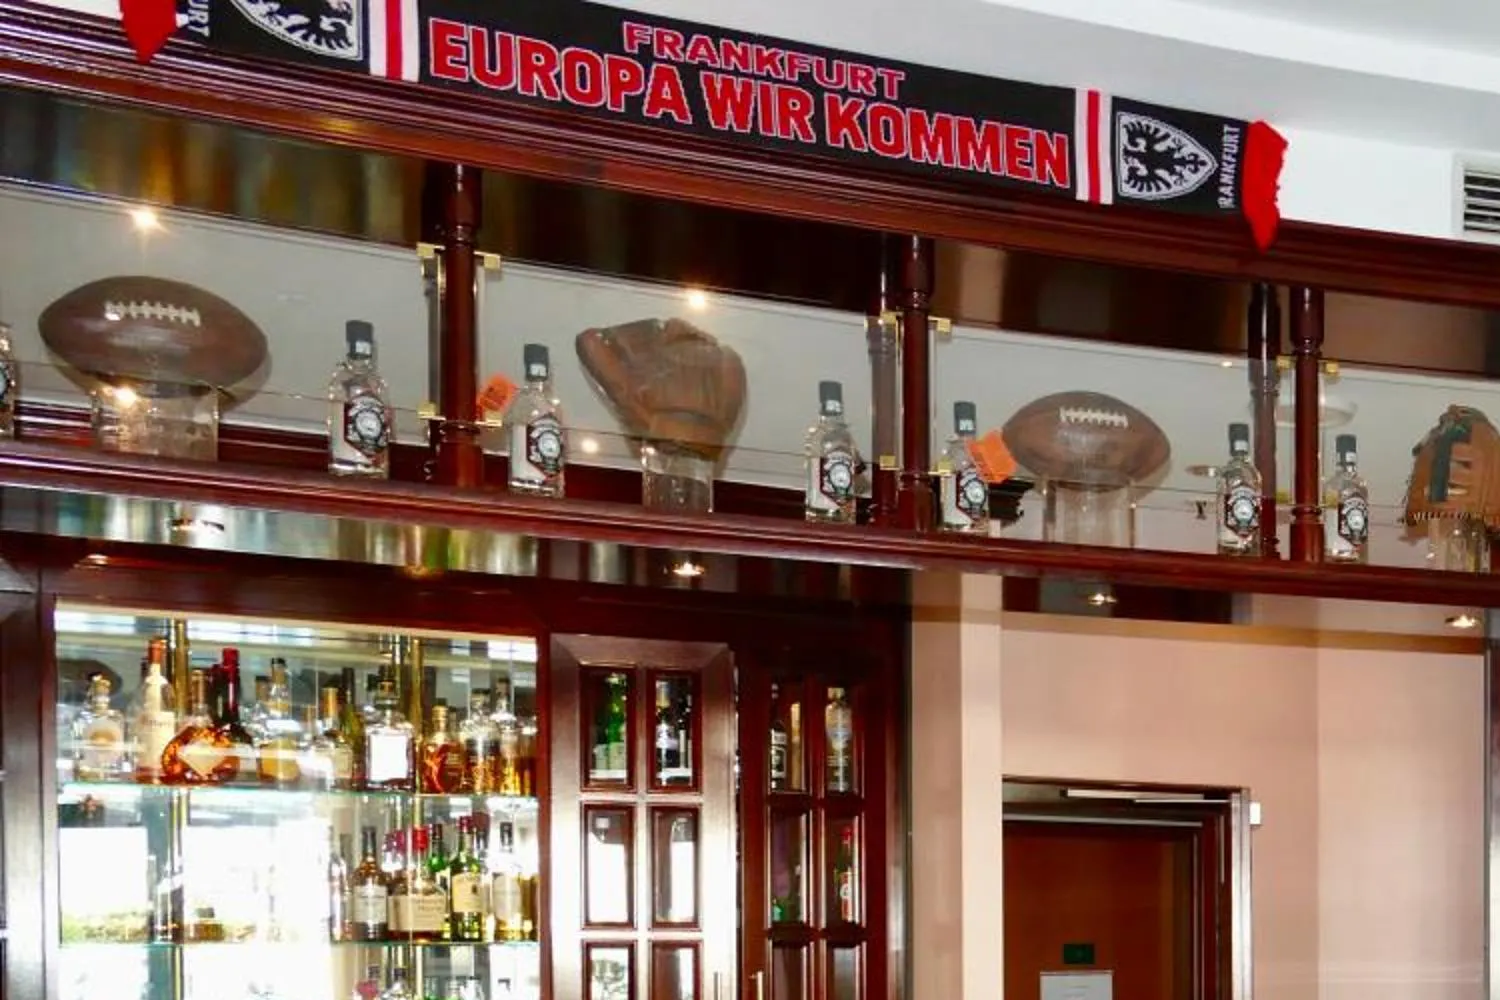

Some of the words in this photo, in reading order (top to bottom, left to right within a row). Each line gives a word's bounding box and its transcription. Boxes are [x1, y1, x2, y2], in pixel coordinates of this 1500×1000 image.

[429, 17, 692, 124] EUROPA
[700, 70, 816, 144] WIR
[824, 93, 1070, 189] KOMMEN
[622, 21, 905, 99] FRANKFURT
